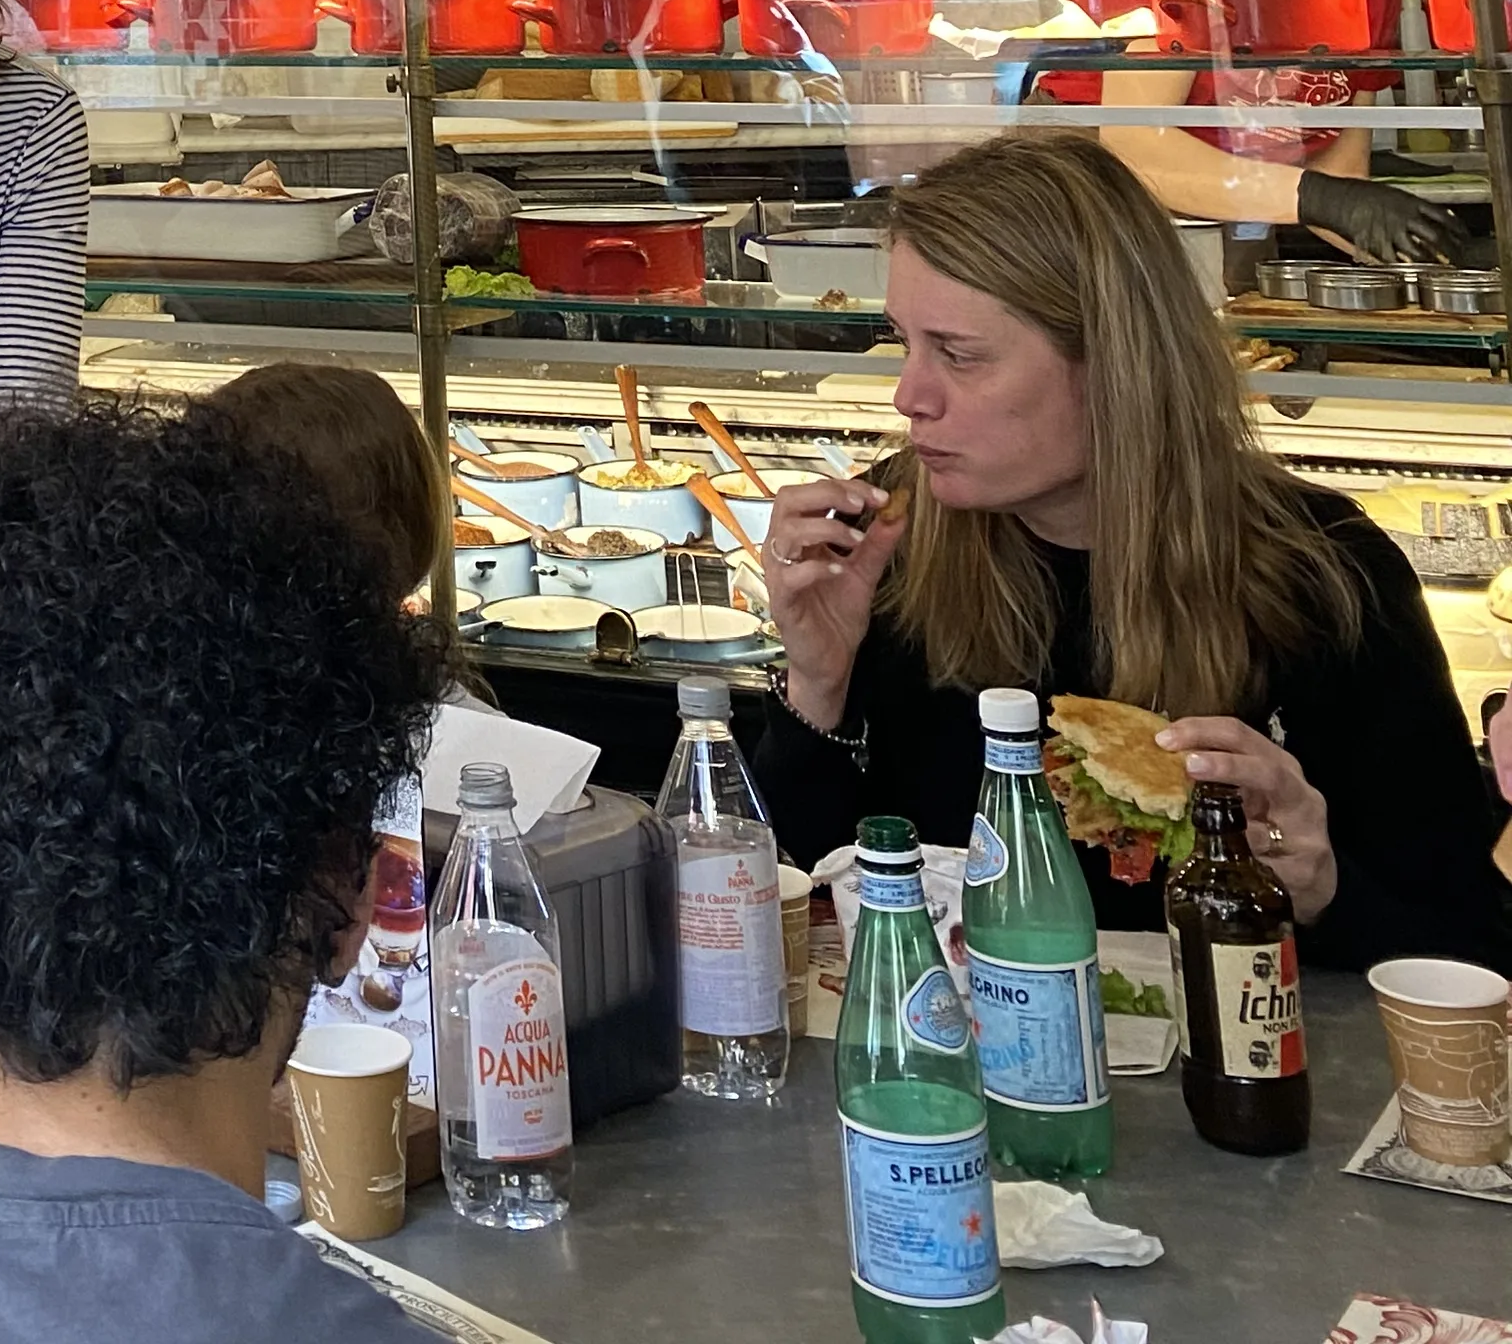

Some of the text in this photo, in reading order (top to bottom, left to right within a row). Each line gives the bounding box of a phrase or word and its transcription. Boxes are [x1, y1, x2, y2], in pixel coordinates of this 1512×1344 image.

[1239, 981, 1296, 1024] ichn
[504, 1019, 551, 1044] ACQUA
[1263, 1021, 1288, 1034] NON
[478, 1038, 566, 1087] PANNA
[506, 1086, 554, 1100] TOSCANA
